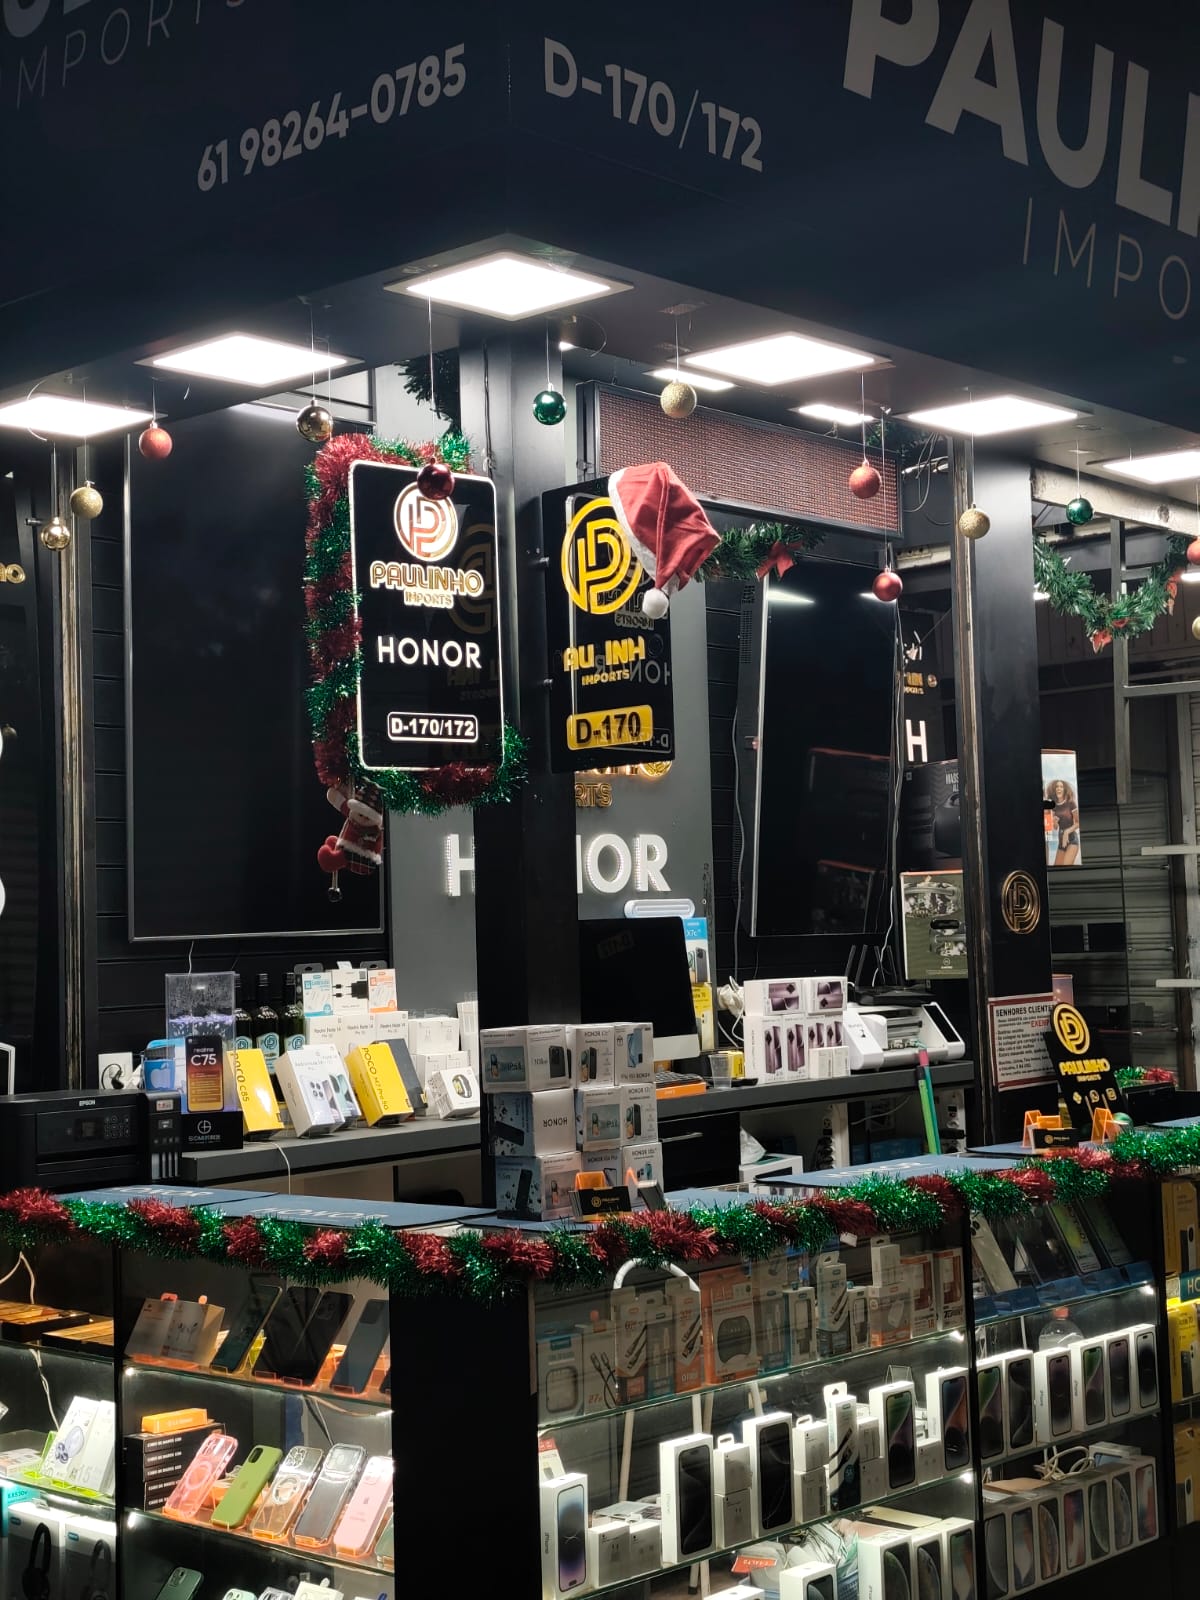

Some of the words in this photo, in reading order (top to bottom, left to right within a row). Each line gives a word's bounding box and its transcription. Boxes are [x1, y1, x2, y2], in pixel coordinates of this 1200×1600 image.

[544, 37, 764, 172] D-170/172
[197, 139, 230, 192] 61
[239, 43, 467, 176] 98264-0785
[370, 560, 485, 597] PAULINHO
[404, 590, 454, 608] IMPORTS
[377, 635, 482, 668] HONOR
[581, 668, 630, 686] IMPORTS
[391, 717, 475, 737] D-170/172
[575, 711, 641, 745] D-170
[996, 1006, 1027, 1017] SENHORES
[190, 1053, 217, 1066] C75
[543, 1117, 567, 1127] HONOR
